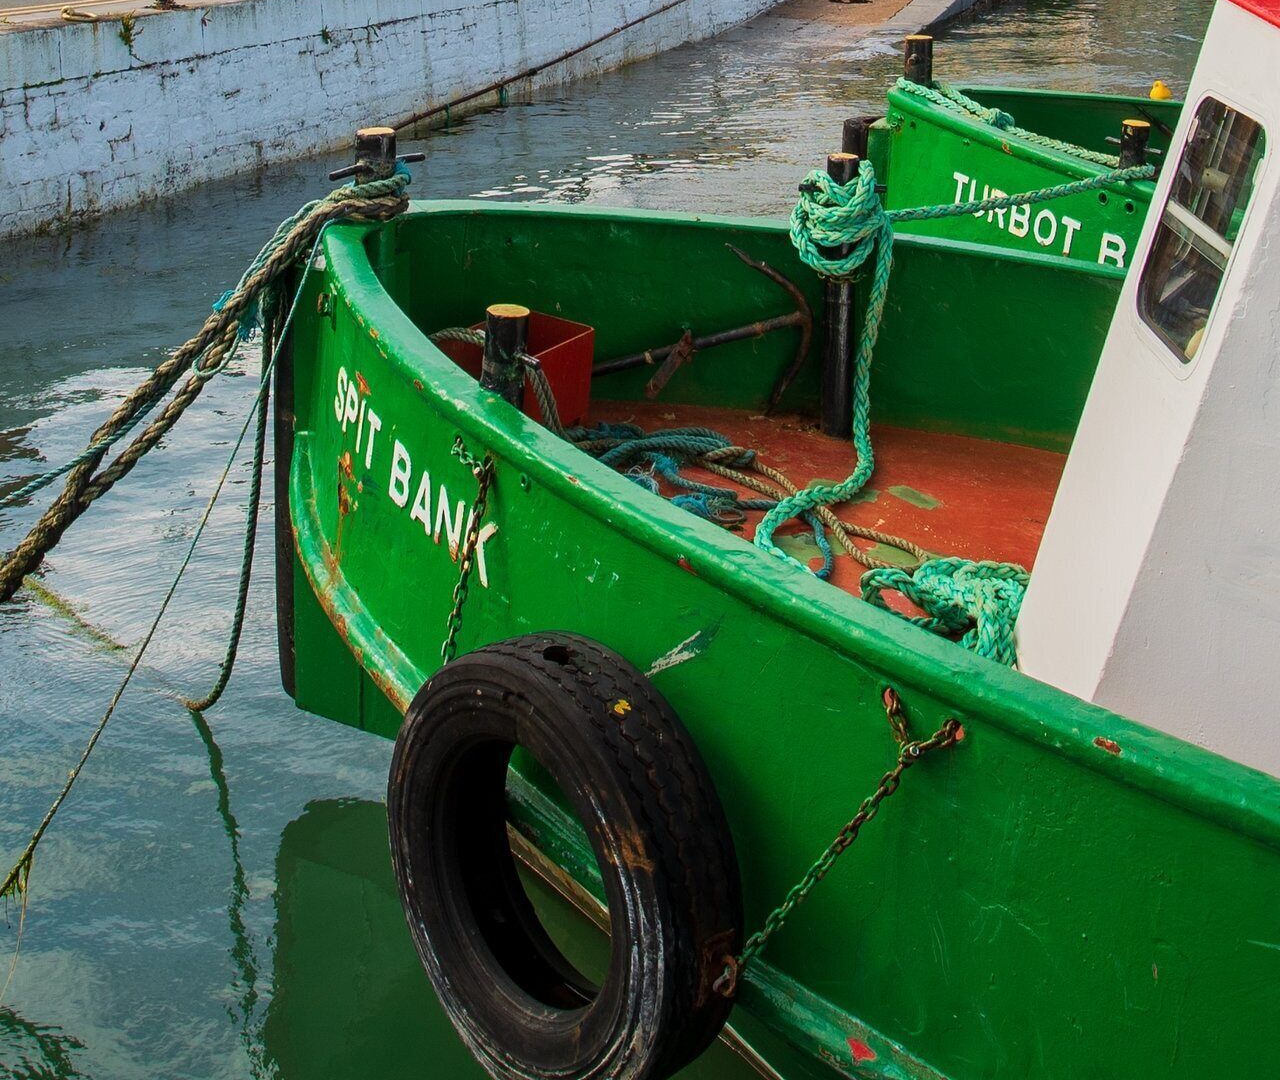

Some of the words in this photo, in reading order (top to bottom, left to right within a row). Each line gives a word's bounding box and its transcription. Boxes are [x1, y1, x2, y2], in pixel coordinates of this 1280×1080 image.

[952, 171, 1082, 257] TURBOT
[334, 366, 383, 470] SPIT
[388, 438, 499, 588] BANK
